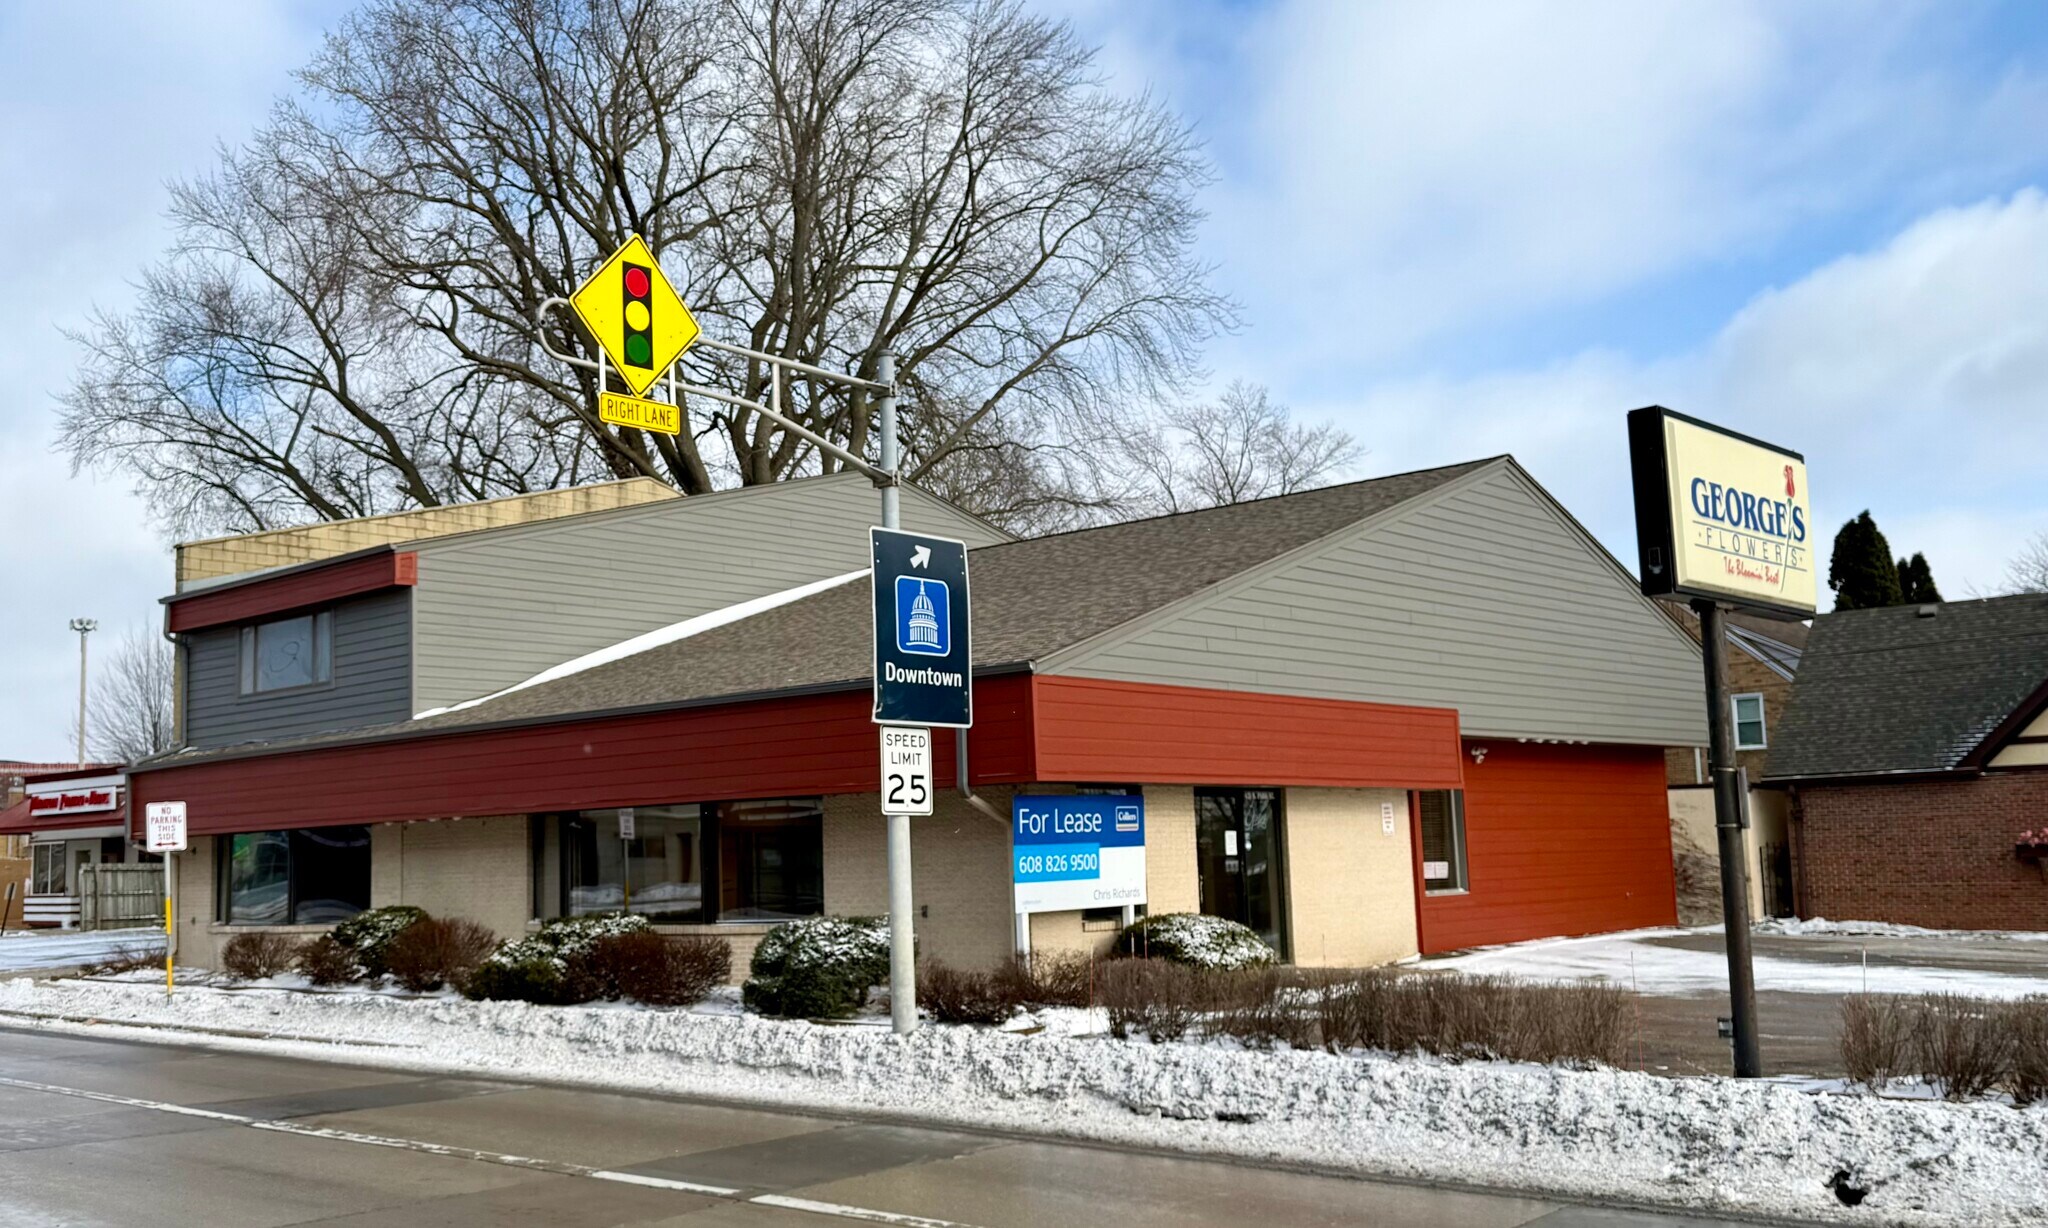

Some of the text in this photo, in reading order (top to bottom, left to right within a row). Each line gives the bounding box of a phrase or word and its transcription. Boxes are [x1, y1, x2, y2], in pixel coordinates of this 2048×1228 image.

[607, 398, 672, 427] RIGHT LANE
[1723, 556, 1734, 575] The
[885, 661, 963, 688] Downtown
[886, 733, 926, 748] SPEED
[891, 752, 922, 766] LIMIT
[888, 773, 927, 805] 25
[161, 806, 172, 815] NO
[150, 815, 183, 825] PARKING
[1019, 808, 1103, 834] For Lease
[157, 833, 175, 841] SIDE
[1019, 853, 1098, 874] 608 826 9500
[1093, 887, 1141, 901] Chris Richards
